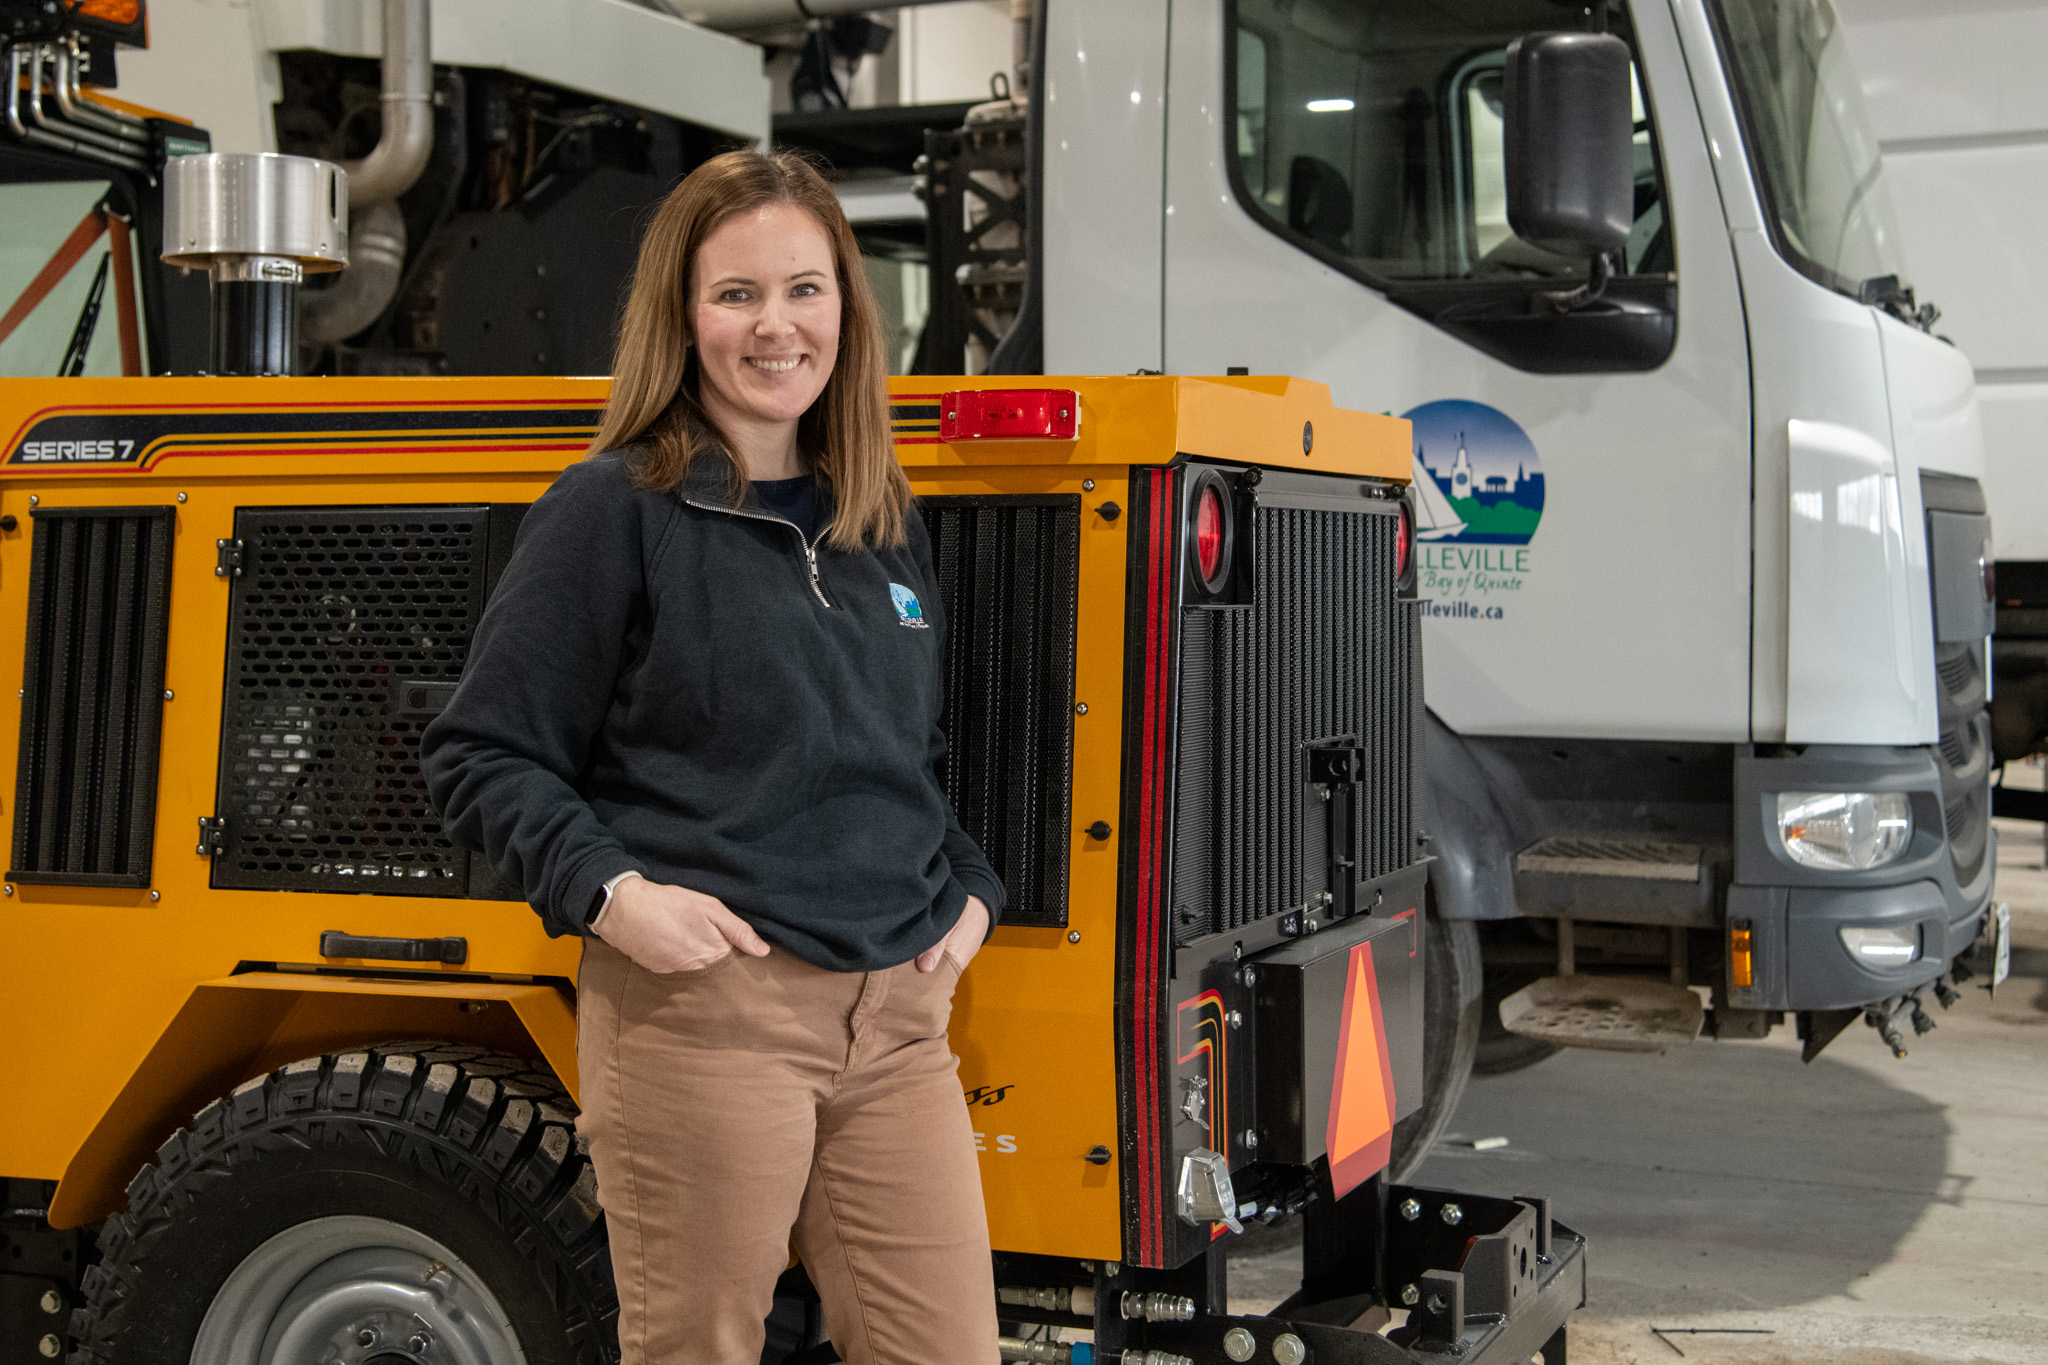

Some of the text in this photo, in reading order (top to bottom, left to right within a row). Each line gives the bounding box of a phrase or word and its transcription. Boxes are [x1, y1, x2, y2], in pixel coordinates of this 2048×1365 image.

[23, 440, 135, 461] SERIES 7
[1417, 547, 1530, 572] LEVILLE
[1424, 570, 1523, 596] Bay of Quinte
